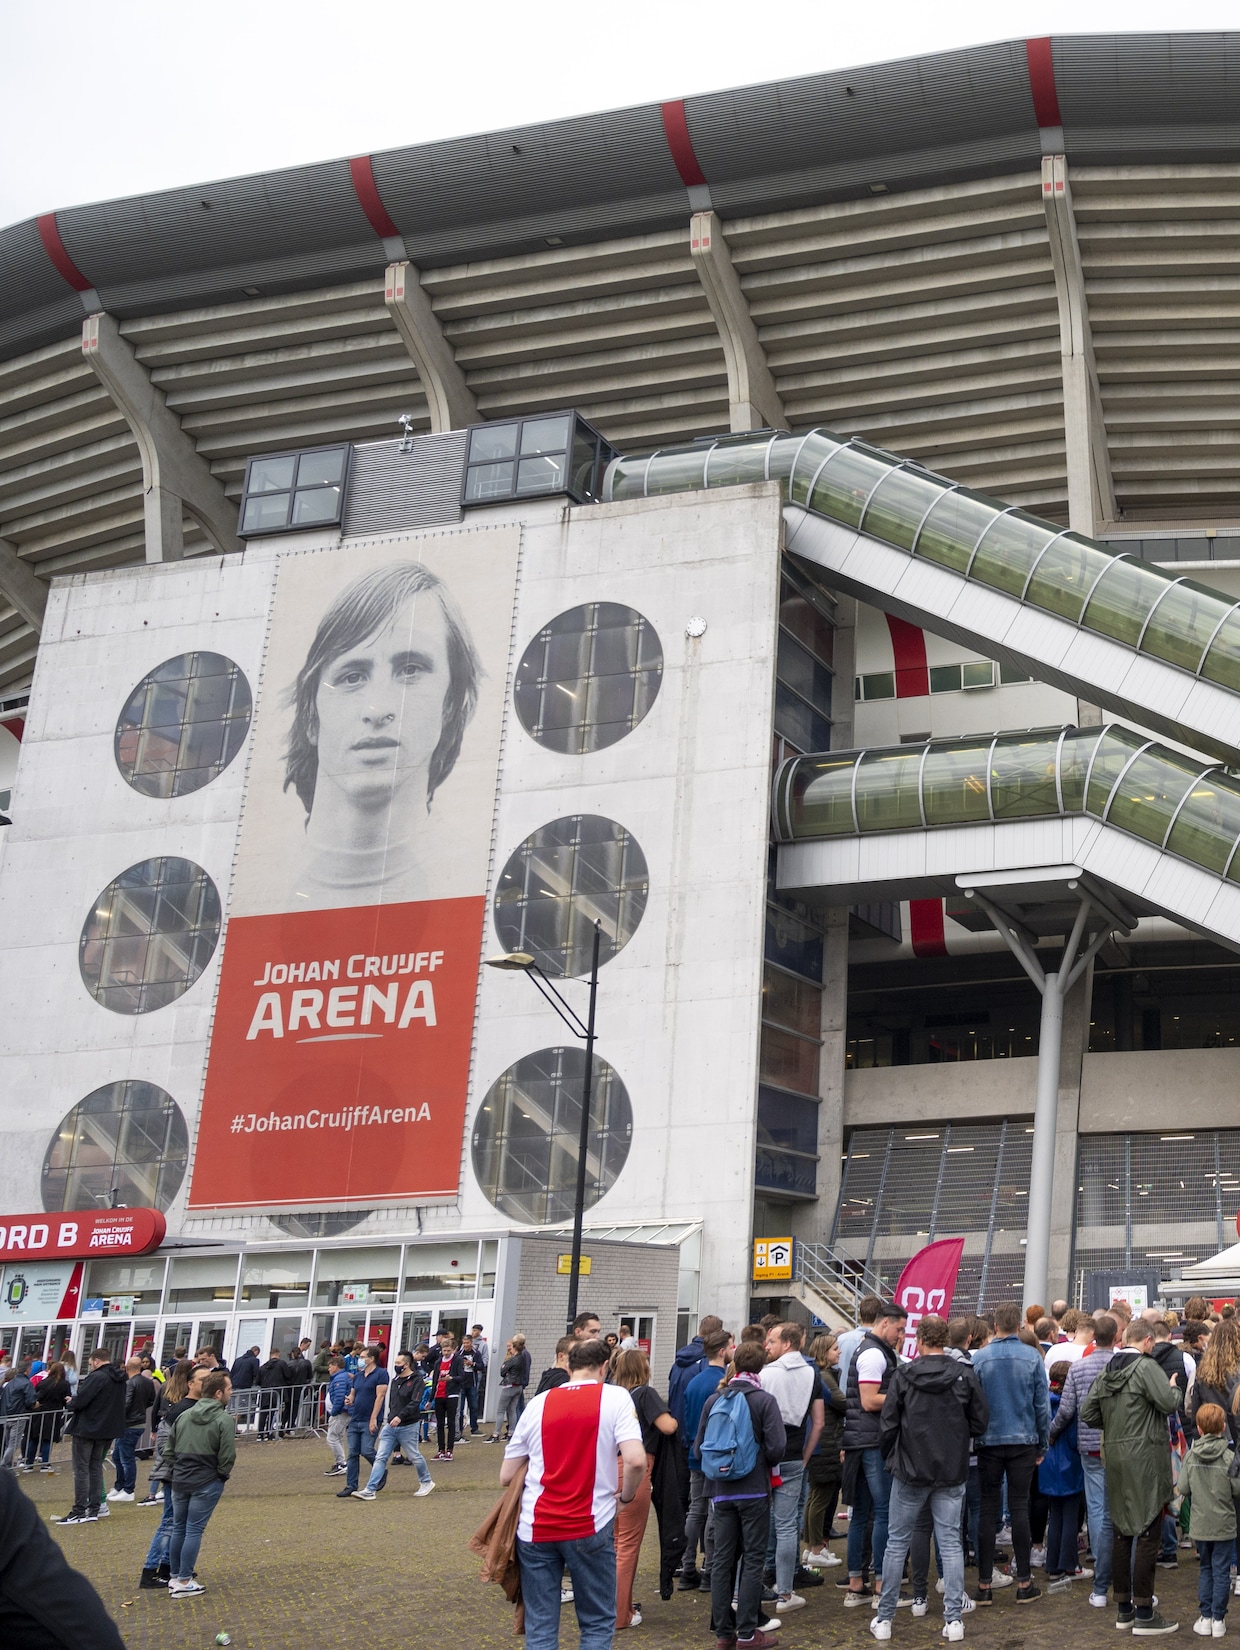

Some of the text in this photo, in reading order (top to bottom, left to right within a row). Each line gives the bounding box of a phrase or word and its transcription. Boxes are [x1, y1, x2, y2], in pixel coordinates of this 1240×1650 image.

[253, 959, 340, 986] JOHAN
[245, 980, 437, 1041] ARENA
[230, 1102, 432, 1134] #JohanCruijffArenA
[57, 1222, 78, 1247] B
[89, 1232, 132, 1247] ARENA
